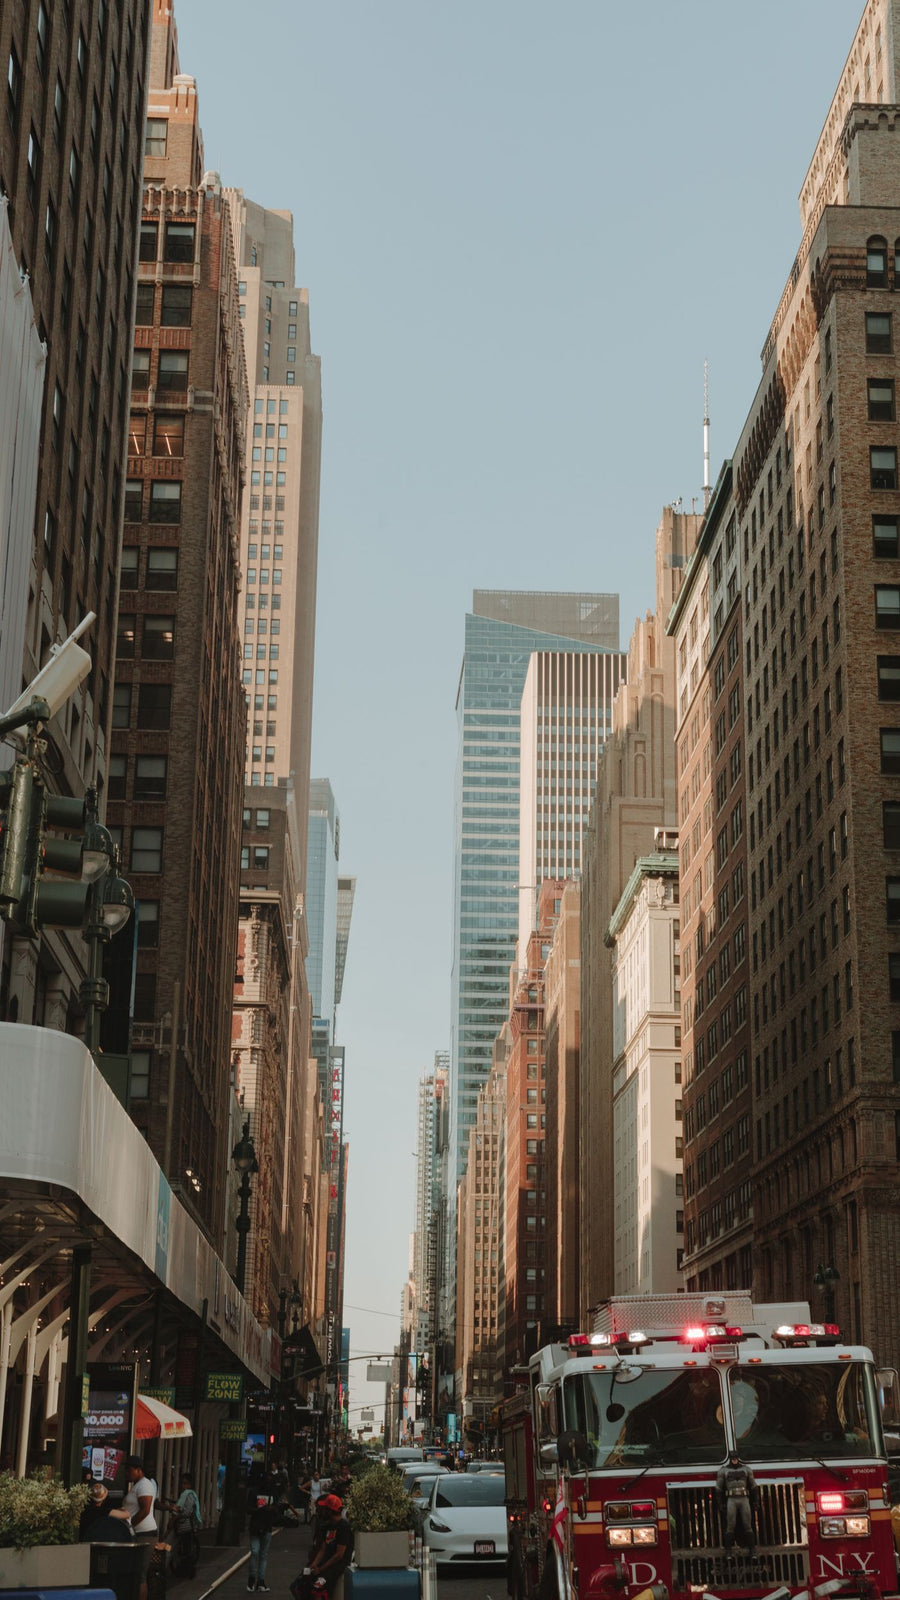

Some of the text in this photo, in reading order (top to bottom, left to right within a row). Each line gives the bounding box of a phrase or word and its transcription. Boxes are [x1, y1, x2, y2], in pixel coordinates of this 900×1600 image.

[208, 1380, 240, 1390] FLOW
[207, 1389, 240, 1400] ZONE
[221, 1424, 246, 1432] FLOW
[220, 1431, 247, 1440] ZONE
[629, 1562, 663, 1586] D.
